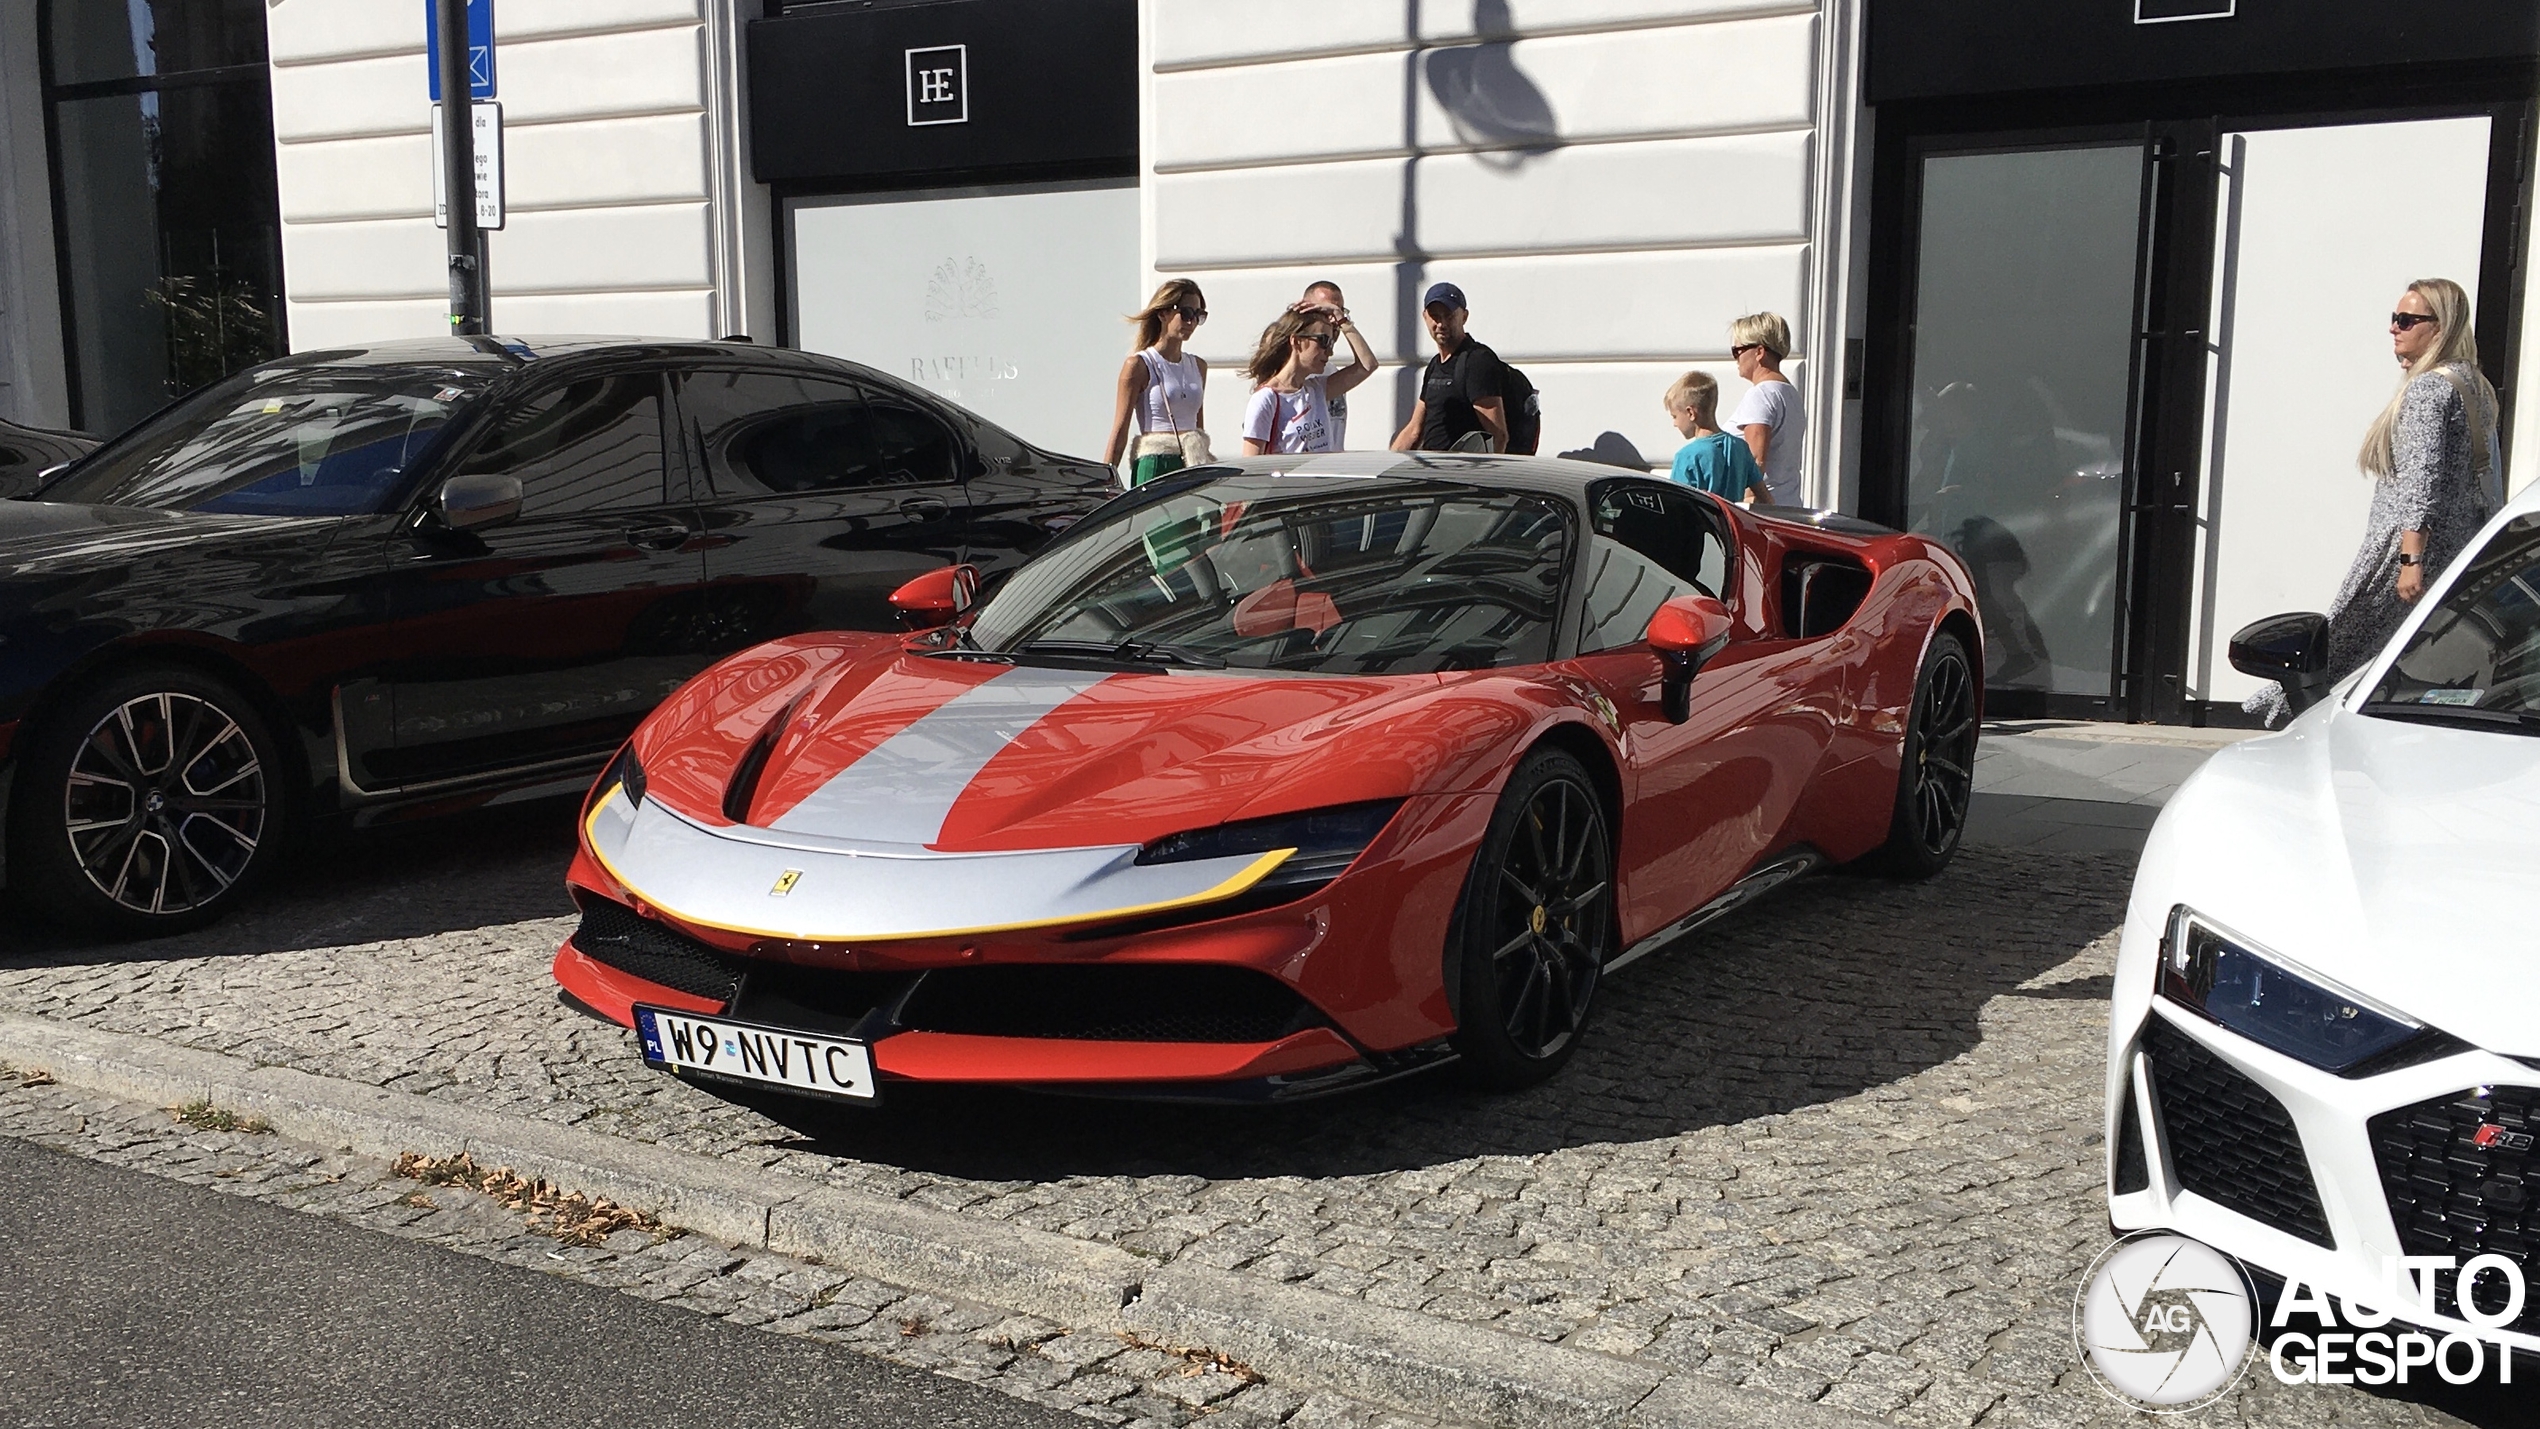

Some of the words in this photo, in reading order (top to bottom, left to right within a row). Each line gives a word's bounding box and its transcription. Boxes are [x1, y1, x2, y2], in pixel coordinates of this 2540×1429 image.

[919, 68, 954, 103] HE
[475, 116, 486, 127] dla
[480, 205, 497, 217] 8-20
[647, 1040, 662, 1053] PL
[668, 1019, 719, 1065] W9
[738, 1031, 854, 1088] NVTC
